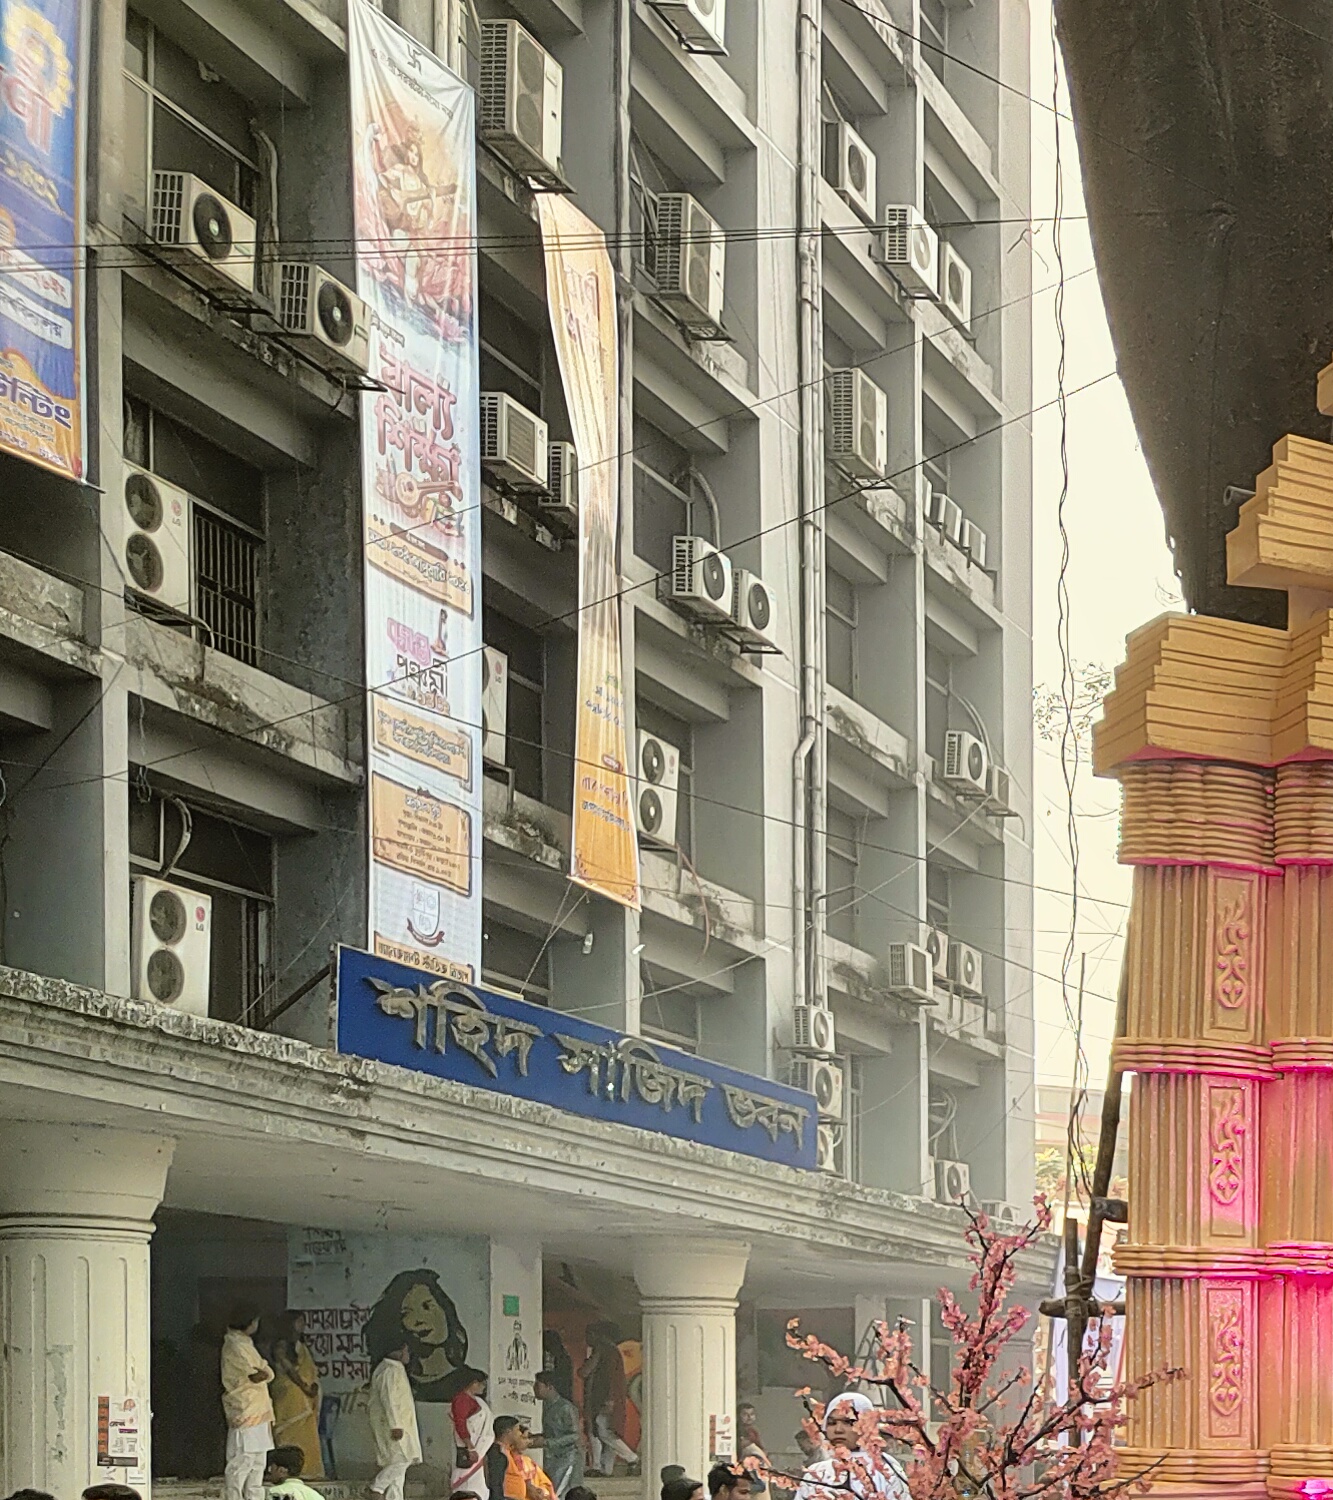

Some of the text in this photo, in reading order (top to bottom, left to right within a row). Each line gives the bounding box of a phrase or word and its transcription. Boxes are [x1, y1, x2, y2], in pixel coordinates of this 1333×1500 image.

[374, 394, 462, 482] শিক্ষা
[379, 341, 457, 441] বাল্য
[362, 975, 810, 1153] শহিদ সাজিদ ভবন
